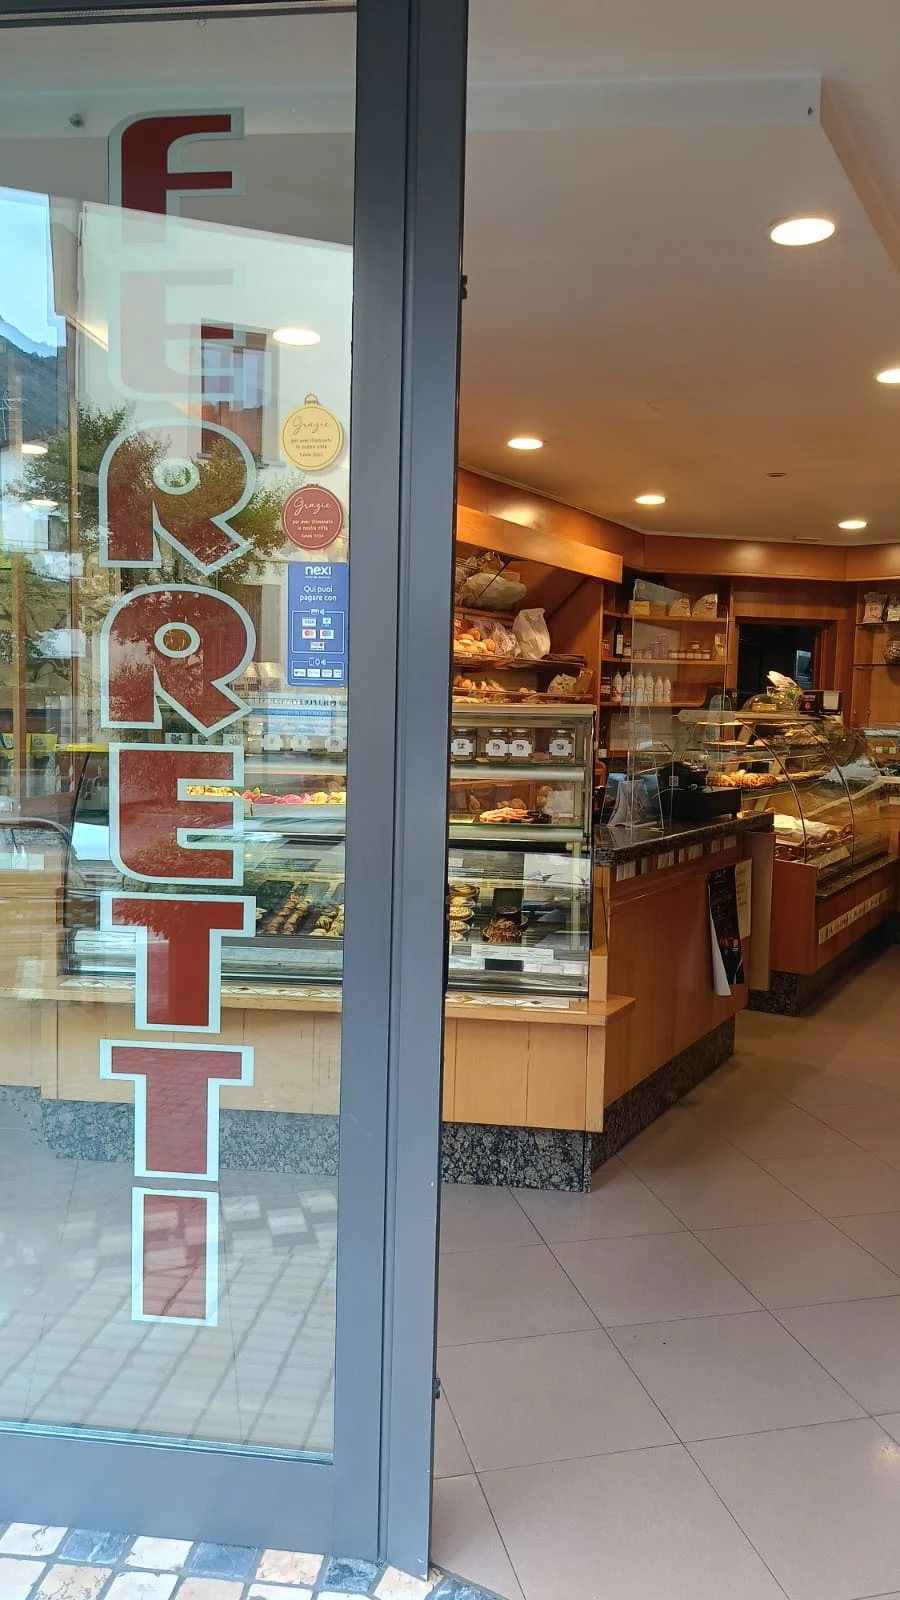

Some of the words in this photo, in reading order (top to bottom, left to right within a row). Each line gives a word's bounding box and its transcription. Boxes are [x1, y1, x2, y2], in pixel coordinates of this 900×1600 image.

[292, 416, 330, 435] Grazie
[293, 496, 332, 516] Grazie
[305, 566, 332, 575] nexi
[303, 585, 316, 594] Qui
[317, 585, 333, 594] puoi
[299, 594, 323, 602] pagare
[98, 107, 257, 1327] FERRETTI
